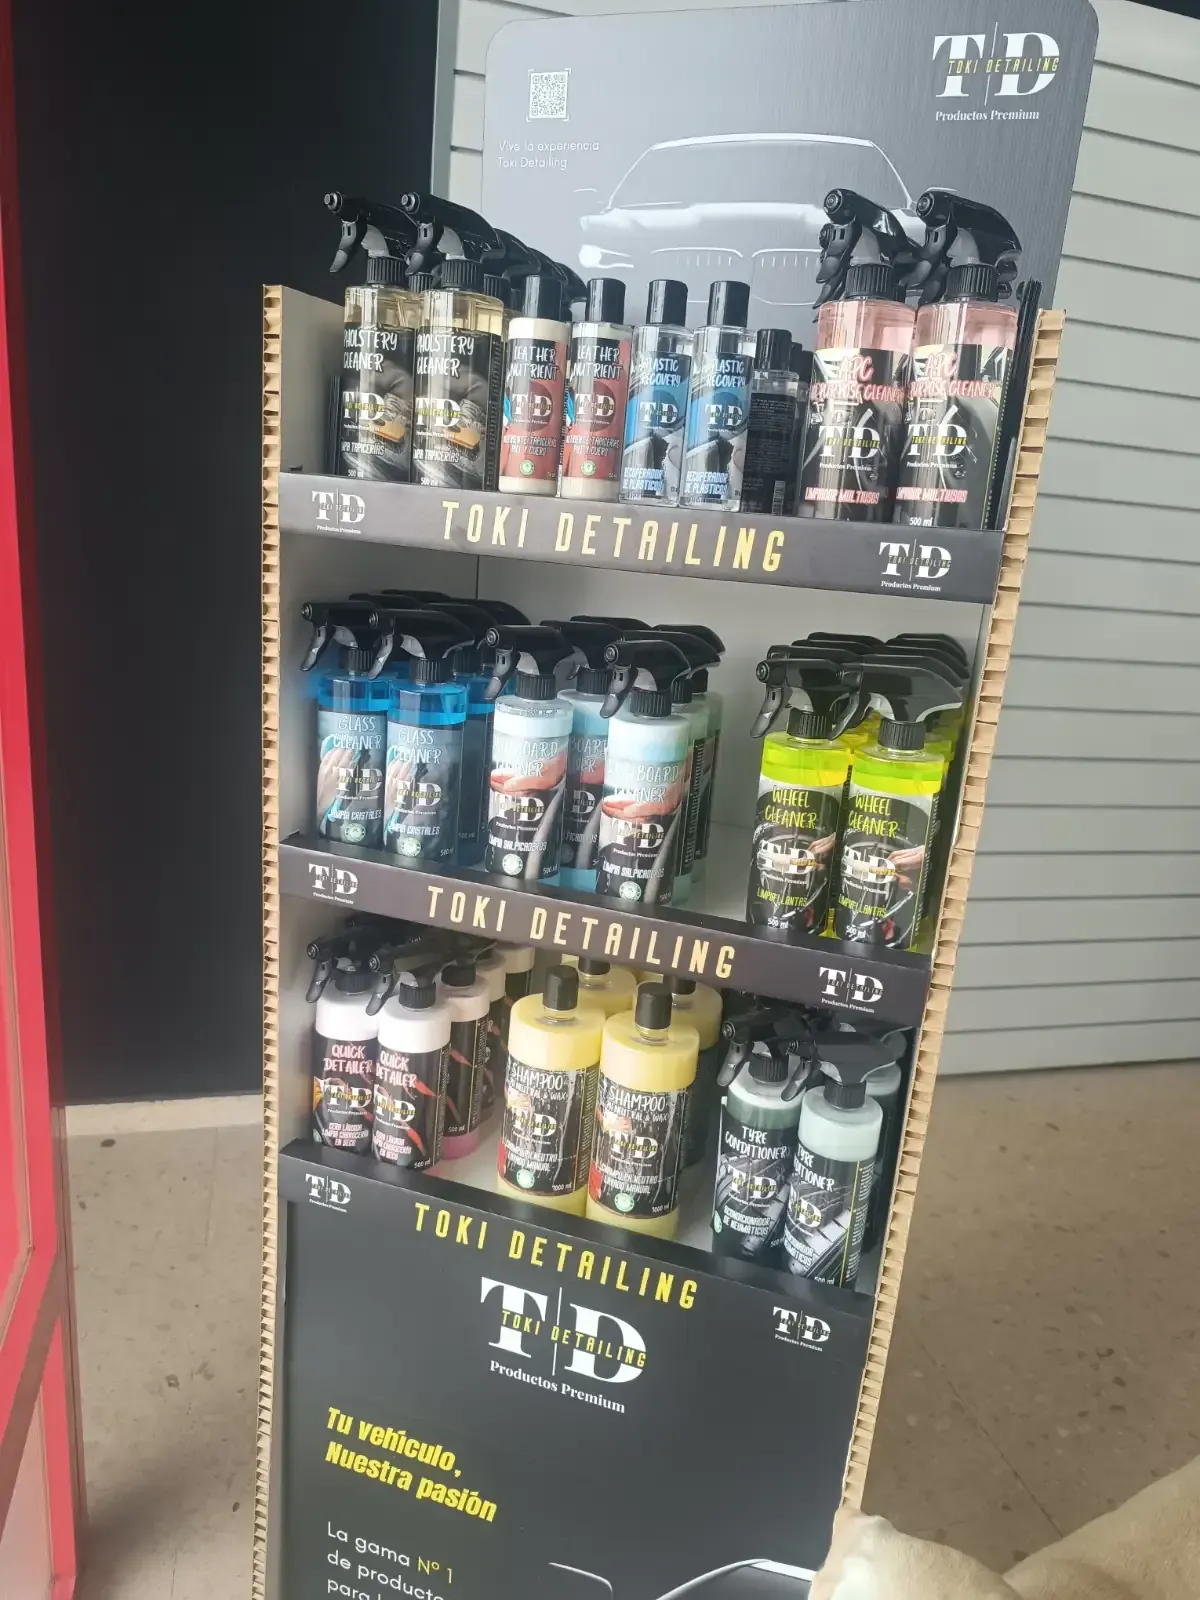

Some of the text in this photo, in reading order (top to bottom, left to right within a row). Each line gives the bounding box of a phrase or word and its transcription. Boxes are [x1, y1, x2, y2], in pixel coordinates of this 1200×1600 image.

[948, 57, 1060, 74] TOKI DETAILING
[935, 109, 1040, 121] Productos Premium
[499, 140, 600, 153] Vive la experiencia
[498, 156, 568, 171] Toki Detailing
[343, 351, 383, 373] CLEANER
[514, 345, 556, 363] LEATHER
[577, 345, 620, 363] LEATHER
[416, 357, 461, 379] CLEANER
[510, 361, 559, 381] NUTRIENT
[573, 362, 623, 381] NUTRIENT
[838, 355, 873, 382] APC
[925, 352, 958, 379] APC
[909, 516, 933, 527] 500 ml
[442, 498, 786, 571] TOKI DETAILING
[881, 580, 941, 592] Productos Premium
[338, 715, 376, 732] GLASS
[333, 733, 382, 750] CLEANER
[398, 728, 435, 745] GLASS
[393, 746, 442, 764] CLEANER
[772, 787, 810, 809] WHEEL
[855, 793, 891, 816] WHEEL
[351, 809, 382, 820] CRISTALES
[764, 805, 817, 829] CLEANER
[848, 810, 899, 838] CLEANER
[406, 825, 440, 836] CRISTALES
[428, 885, 735, 979] TOKI DETAILING
[767, 917, 789, 929] 500 ml
[846, 925, 867, 939] 500 ml
[821, 997, 875, 1013] Productos Premium
[331, 1044, 365, 1060] QUICK
[379, 1050, 410, 1071] QUICK
[323, 1057, 372, 1074] DETAILER
[376, 1063, 418, 1088] DETAILER
[511, 1063, 564, 1091] SHAMPOO
[608, 1085, 665, 1112] SHAMPOO
[742, 1125, 768, 1144] TYRE
[725, 1130, 787, 1160] CONDITIONER
[414, 1201, 698, 1310] TOKI DETAILING
[502, 1309, 647, 1368] TOKI DETAILING
[774, 1333, 823, 1352] Productos Premium
[490, 1359, 626, 1414] Productos Premium
[326, 1406, 462, 1478] Tu vehículo,
[325, 1441, 498, 1523] Nuestra pasión
[327, 1549, 352, 1570] de
[328, 1521, 453, 1584] La gama Nº 1
[327, 1579, 370, 1600] para
